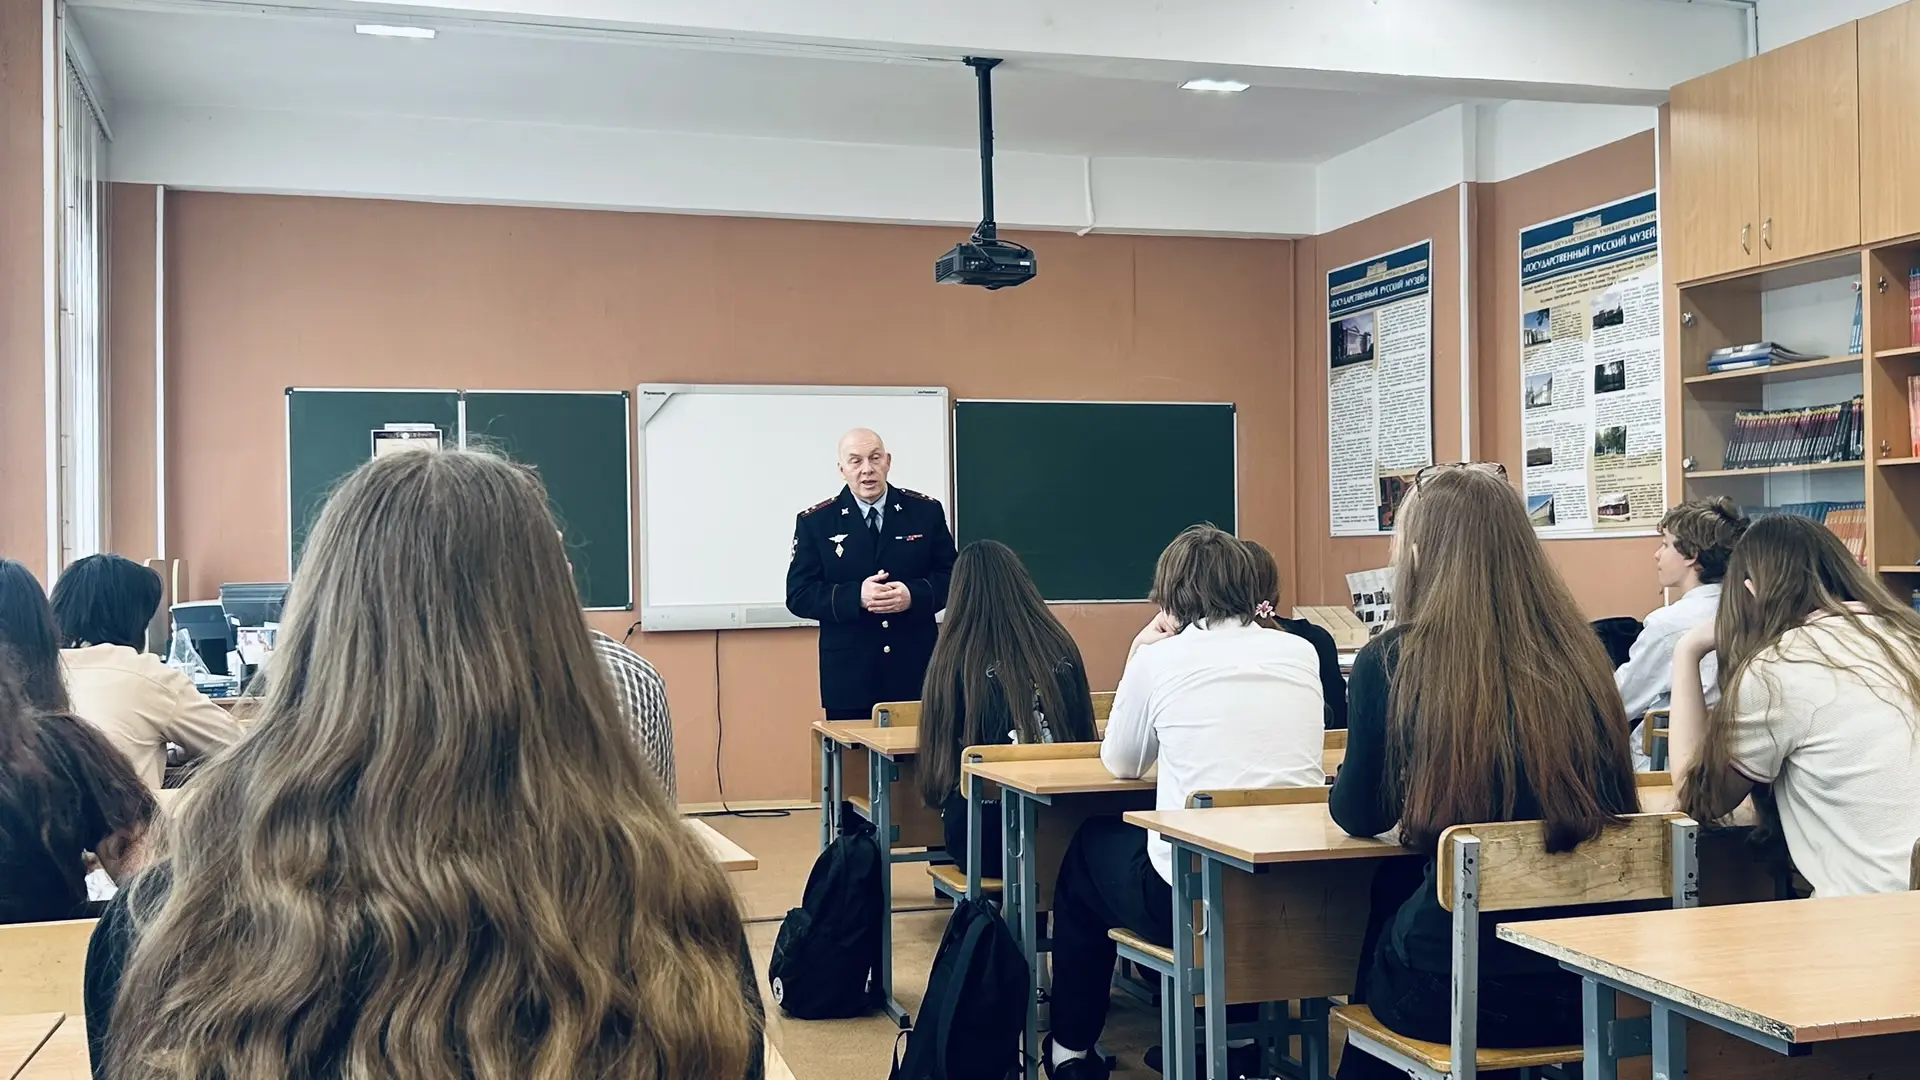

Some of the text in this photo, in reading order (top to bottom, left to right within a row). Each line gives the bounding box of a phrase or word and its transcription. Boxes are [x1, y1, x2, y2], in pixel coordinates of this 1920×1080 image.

[1523, 245, 1590, 273] «ГОСУДАРСТВЕННЫЙ
[1592, 234, 1626, 254] РУССКИЙ
[1629, 226, 1657, 244] МУЗЕЙ
[1380, 279, 1404, 295] РУССКИЙ
